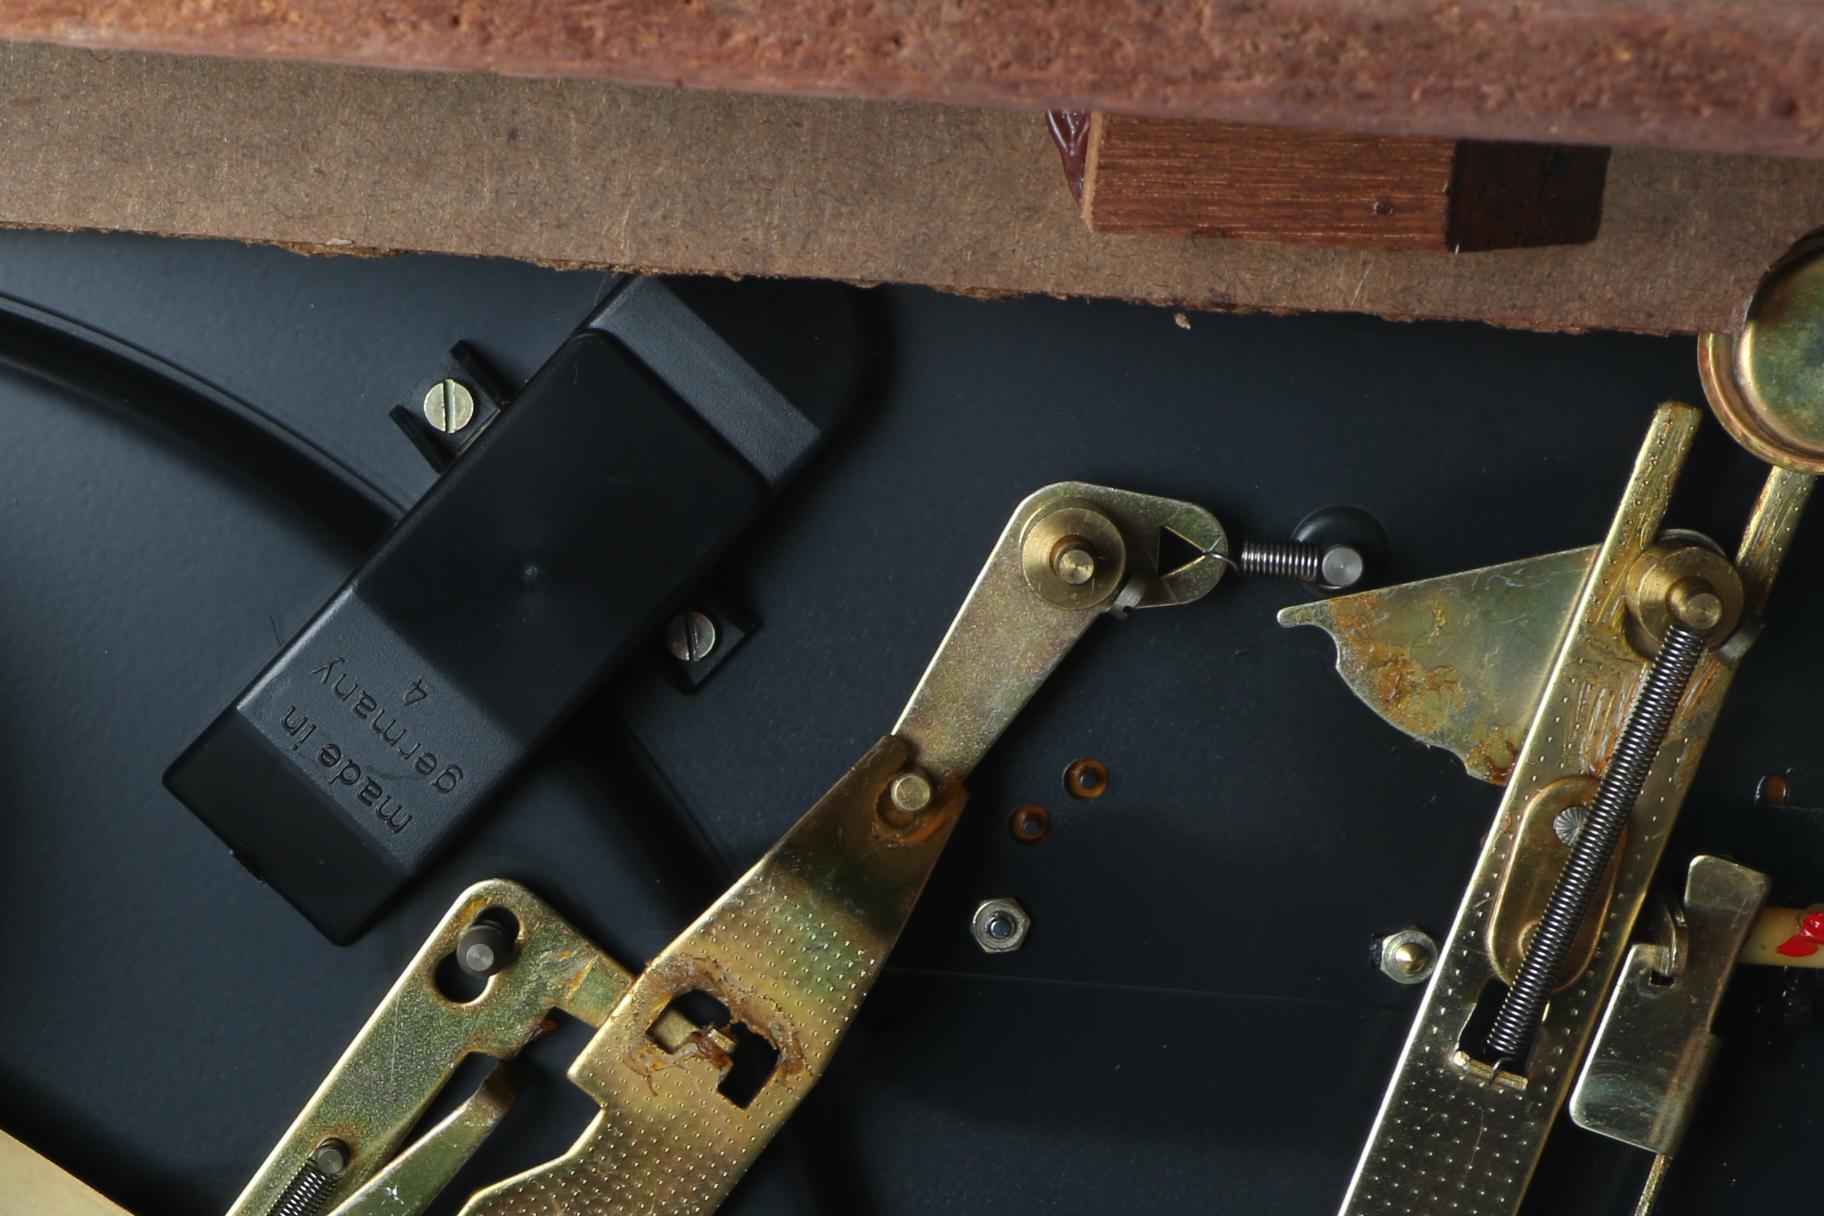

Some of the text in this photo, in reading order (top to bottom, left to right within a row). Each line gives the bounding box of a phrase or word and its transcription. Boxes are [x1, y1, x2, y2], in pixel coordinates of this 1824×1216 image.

[311, 656, 465, 794] germany
[402, 678, 428, 708] 4
[279, 705, 413, 834] made in
